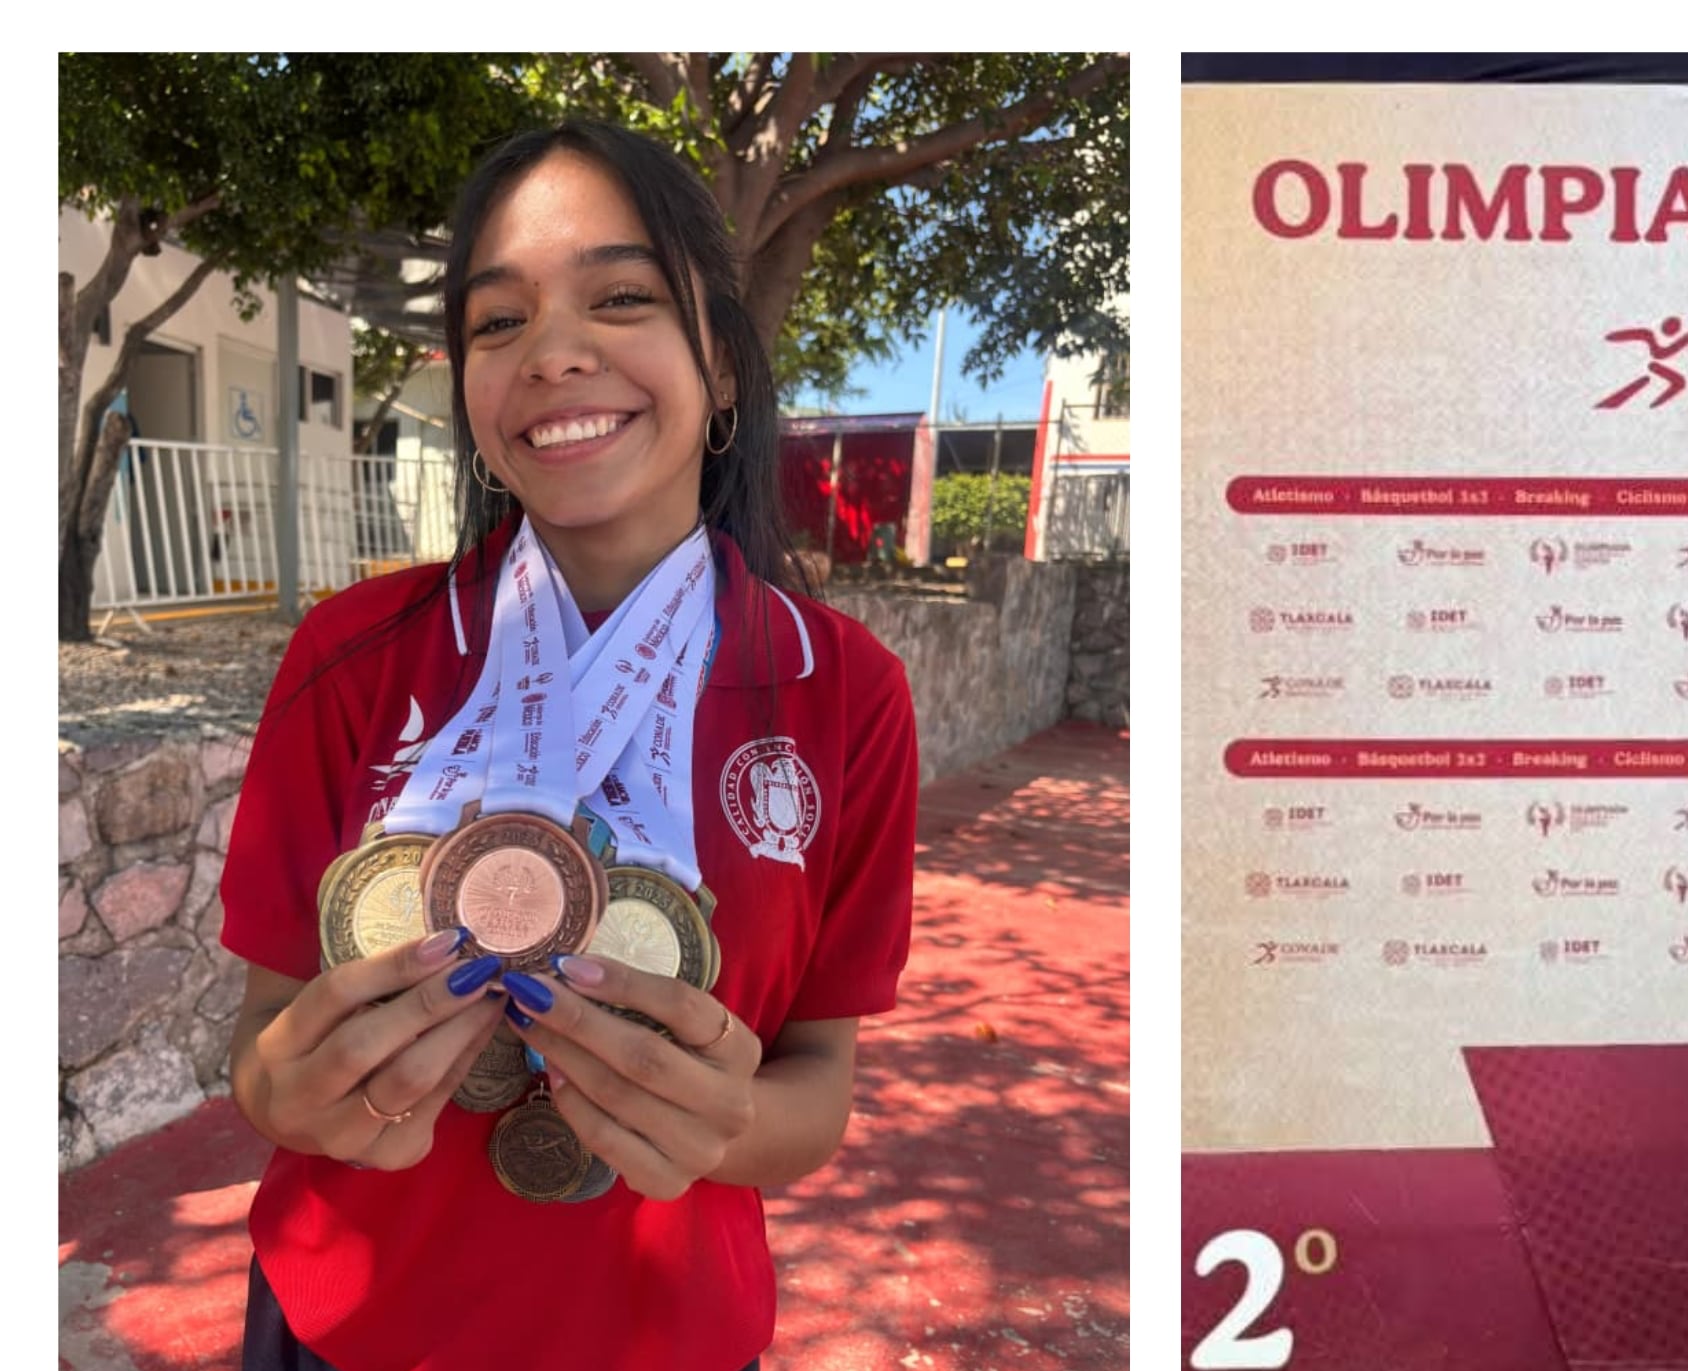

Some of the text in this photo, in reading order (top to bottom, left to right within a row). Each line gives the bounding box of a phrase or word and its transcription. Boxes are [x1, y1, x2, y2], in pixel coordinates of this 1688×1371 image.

[1252, 488, 1334, 504] Atletismo
[1514, 489, 1591, 508] Breaking
[1616, 490, 1687, 505] Ciclismo
[1250, 752, 1332, 767] Atletismo
[1512, 752, 1588, 771] Breaking
[1614, 752, 1685, 767] Ciclismo
